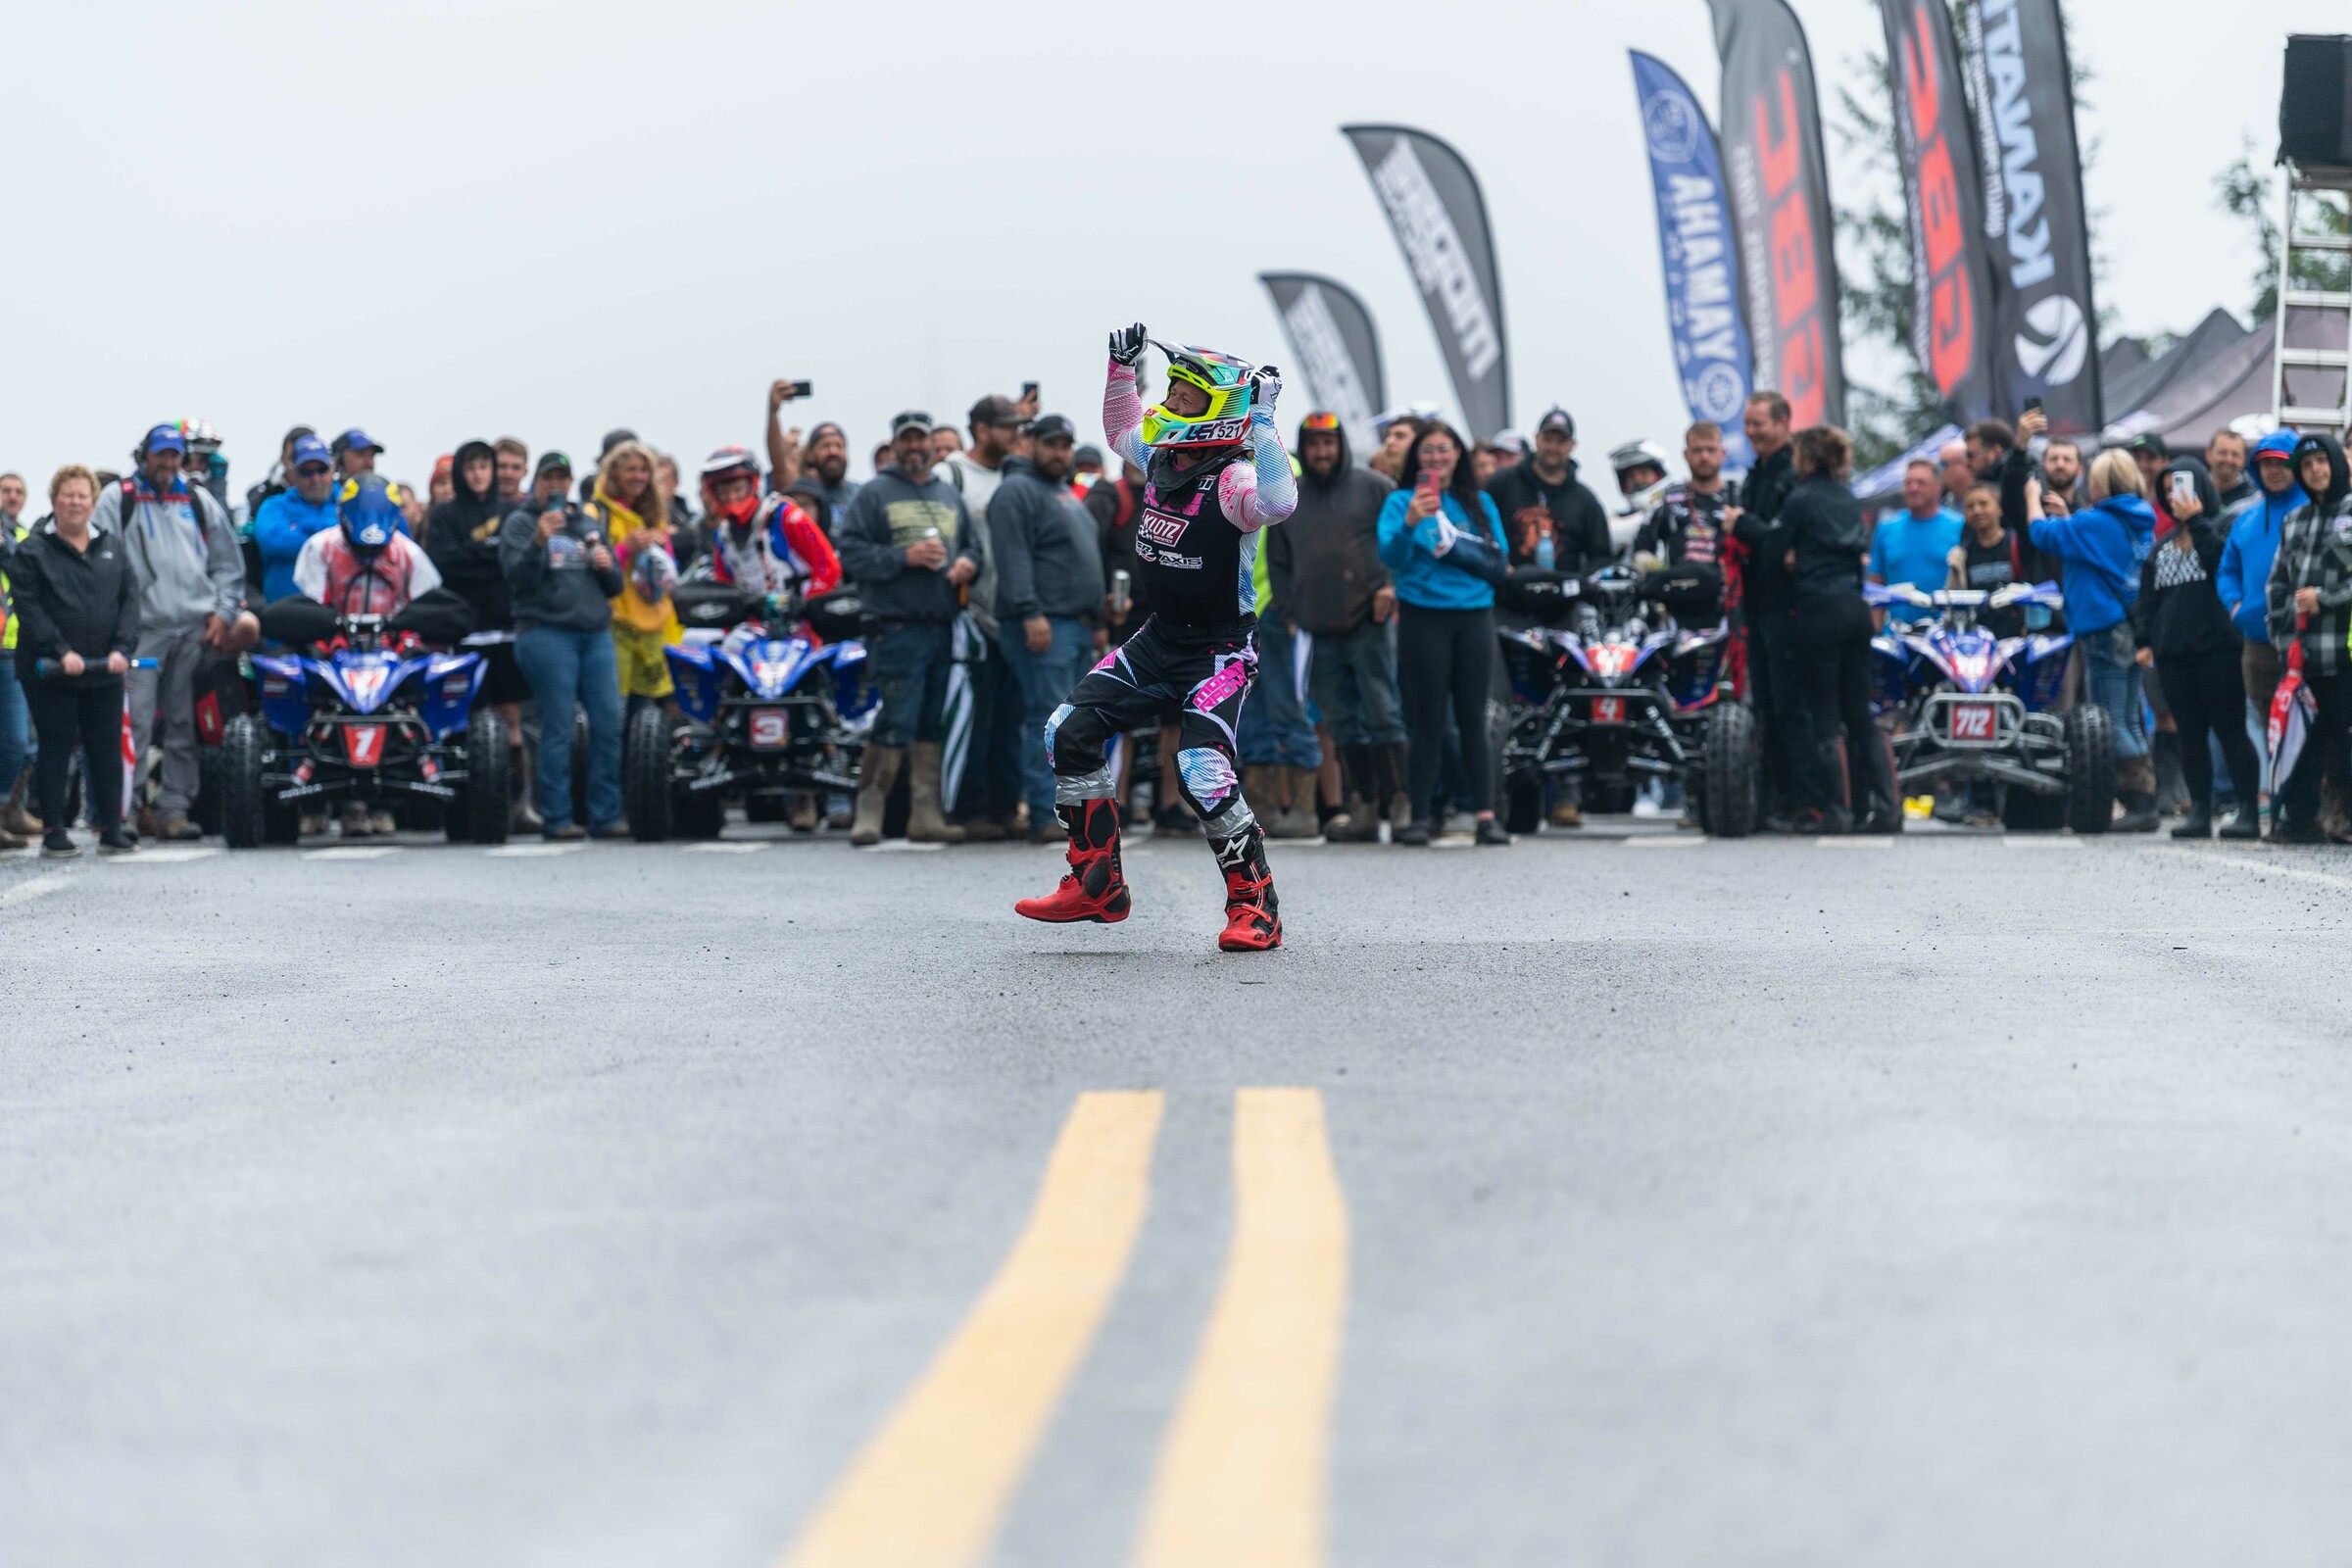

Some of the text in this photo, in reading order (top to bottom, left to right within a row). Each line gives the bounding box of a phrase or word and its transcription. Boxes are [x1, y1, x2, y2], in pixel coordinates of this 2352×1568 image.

[1217, 425, 1241, 438] 521
[1143, 514, 1182, 539] KLOTZ
[1159, 555, 1202, 565] AXIS
[1599, 697, 1618, 721] 4
[754, 715, 783, 745] 3
[1956, 709, 1990, 736] 712
[355, 728, 376, 759] 1
